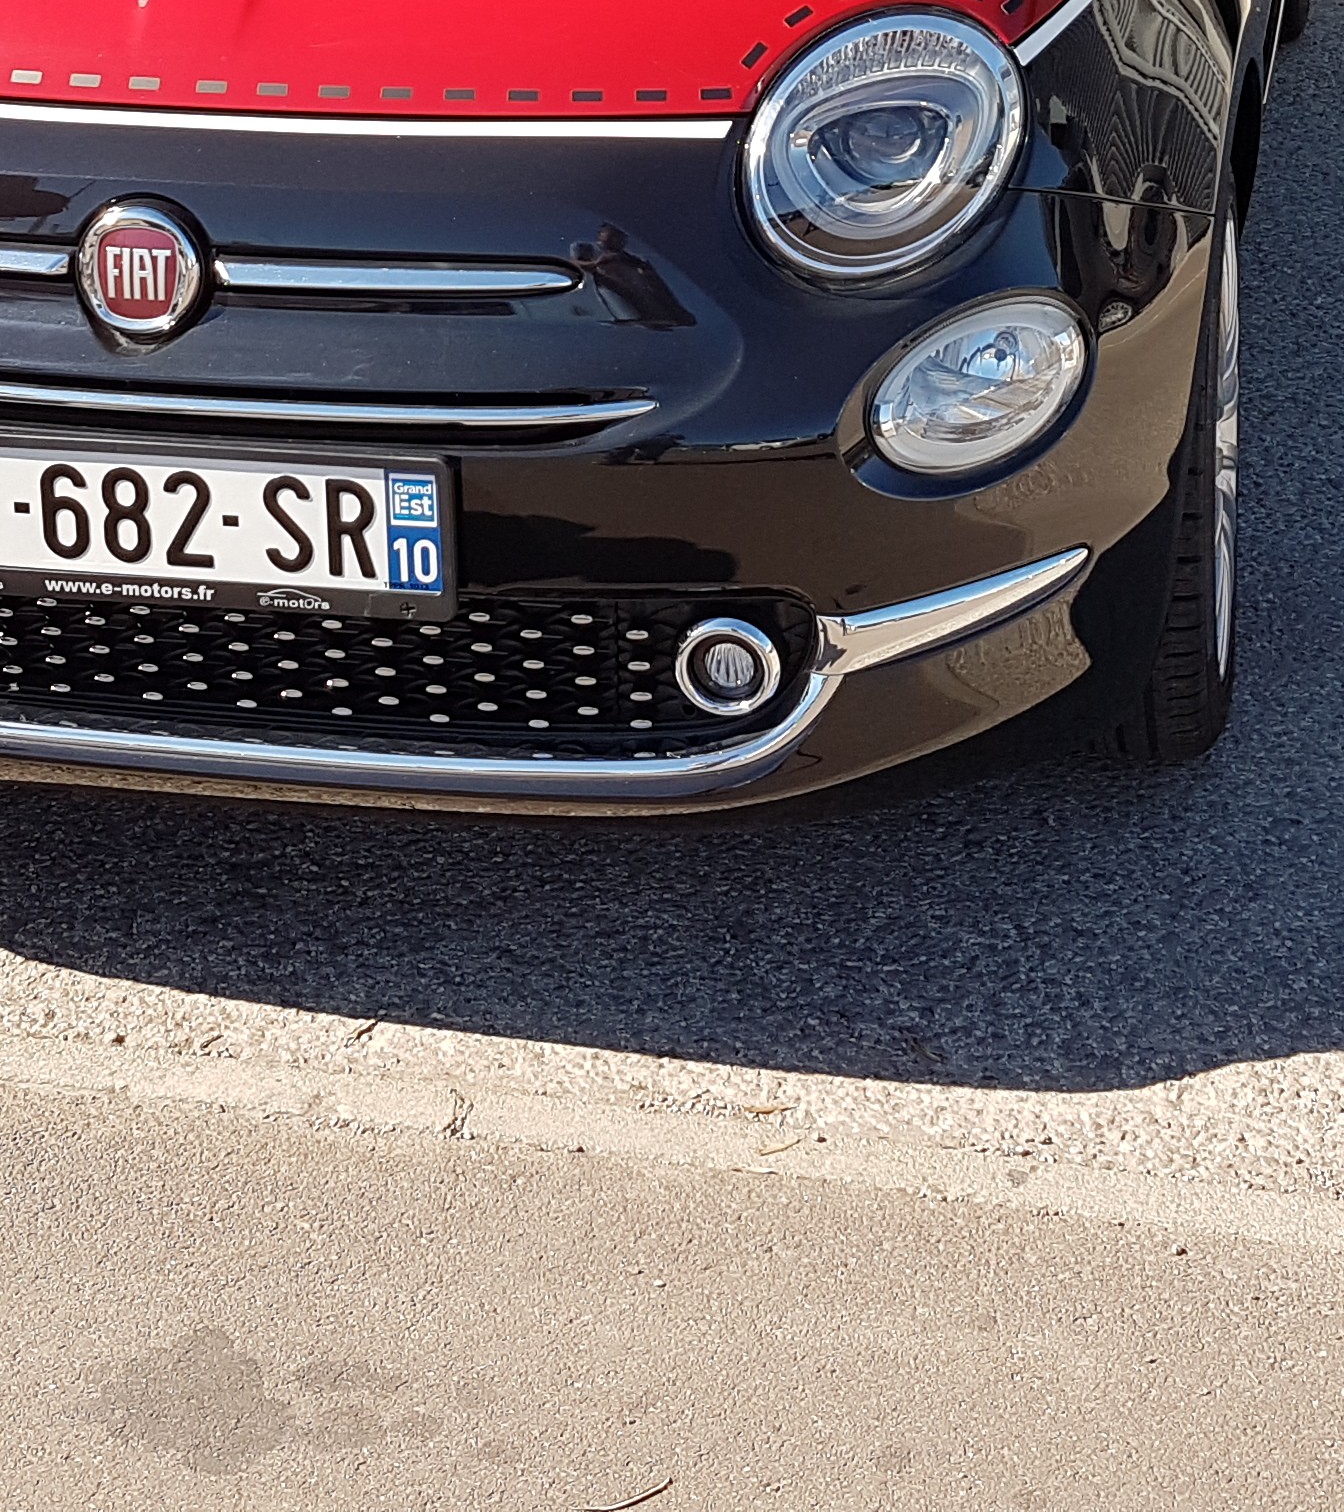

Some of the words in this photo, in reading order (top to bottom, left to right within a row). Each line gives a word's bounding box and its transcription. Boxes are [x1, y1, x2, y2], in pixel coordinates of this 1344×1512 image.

[105, 245, 172, 301] FIAT
[393, 482, 433, 495] Grand
[394, 494, 433, 517] Est
[393, 537, 438, 584] 10
[44, 579, 215, 601] www.e-motors.fr
